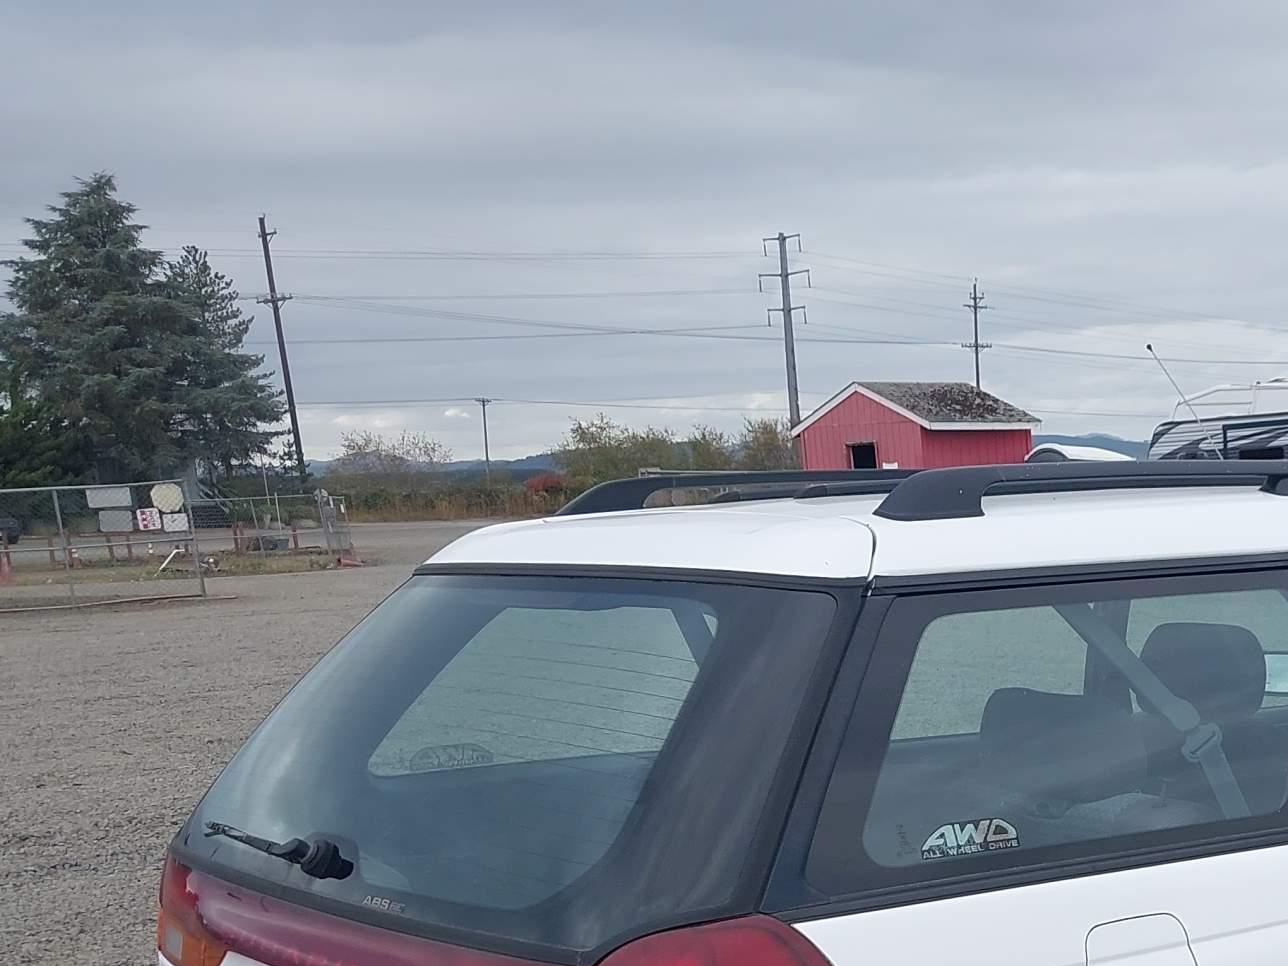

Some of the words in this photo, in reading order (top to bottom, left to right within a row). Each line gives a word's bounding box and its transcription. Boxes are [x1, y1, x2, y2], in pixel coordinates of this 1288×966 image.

[921, 818, 1018, 850] AWD
[923, 849, 945, 859] ALL
[948, 843, 985, 856] WHEEL
[988, 839, 1019, 850] DRIVE
[361, 895, 391, 911] ABS
